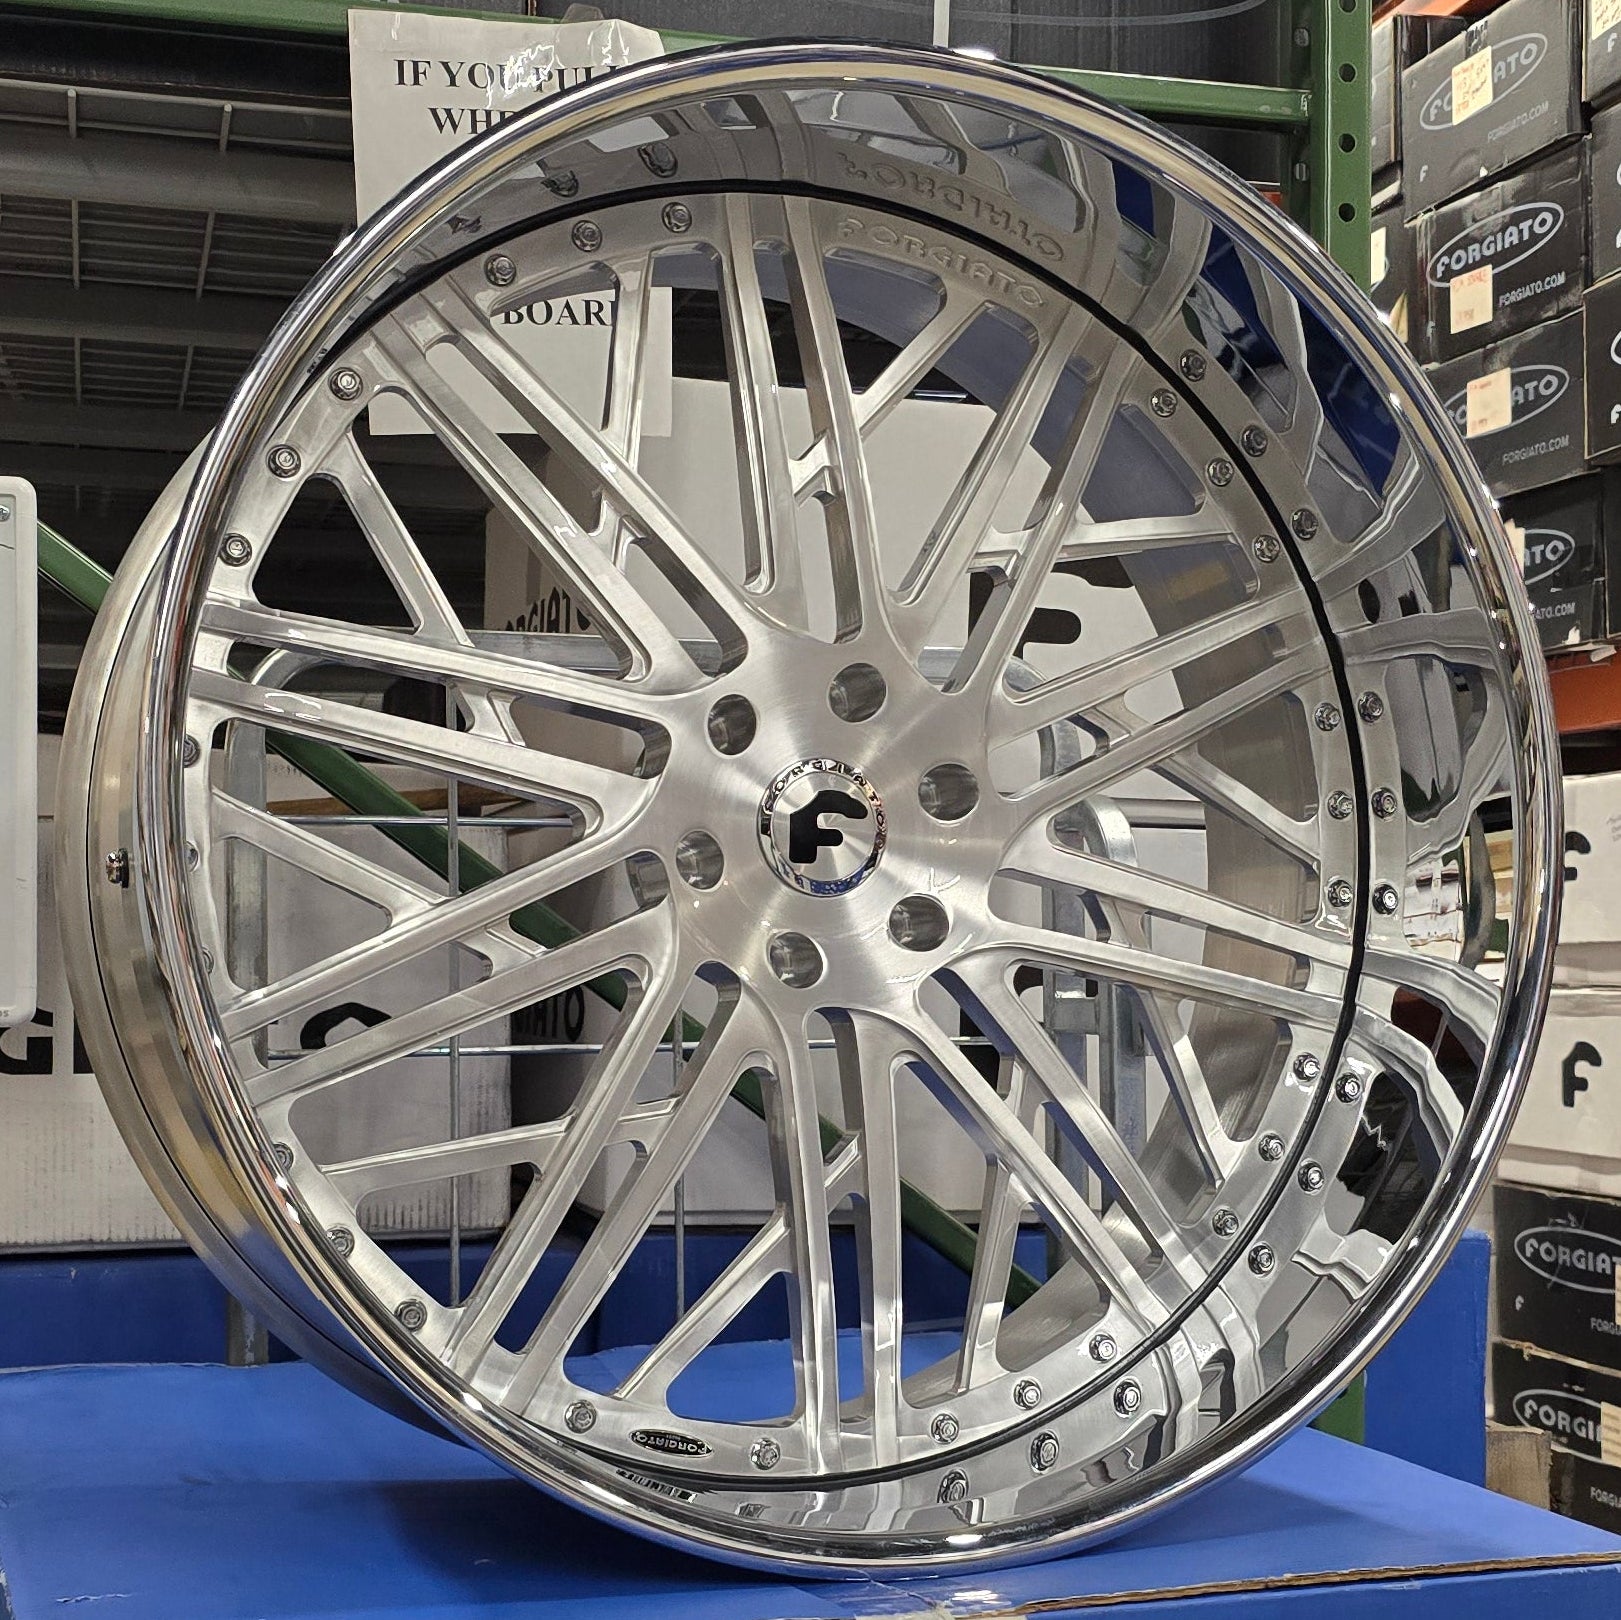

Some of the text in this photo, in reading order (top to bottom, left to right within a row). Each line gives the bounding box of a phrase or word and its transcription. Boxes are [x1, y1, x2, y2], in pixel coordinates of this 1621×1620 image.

[393, 59, 431, 86] IF
[838, 217, 1044, 307] FORGIATO
[1436, 211, 1554, 279] FORGIATO
[1499, 270, 1567, 308] FORGIATO.COM
[502, 300, 614, 326] BOAR
